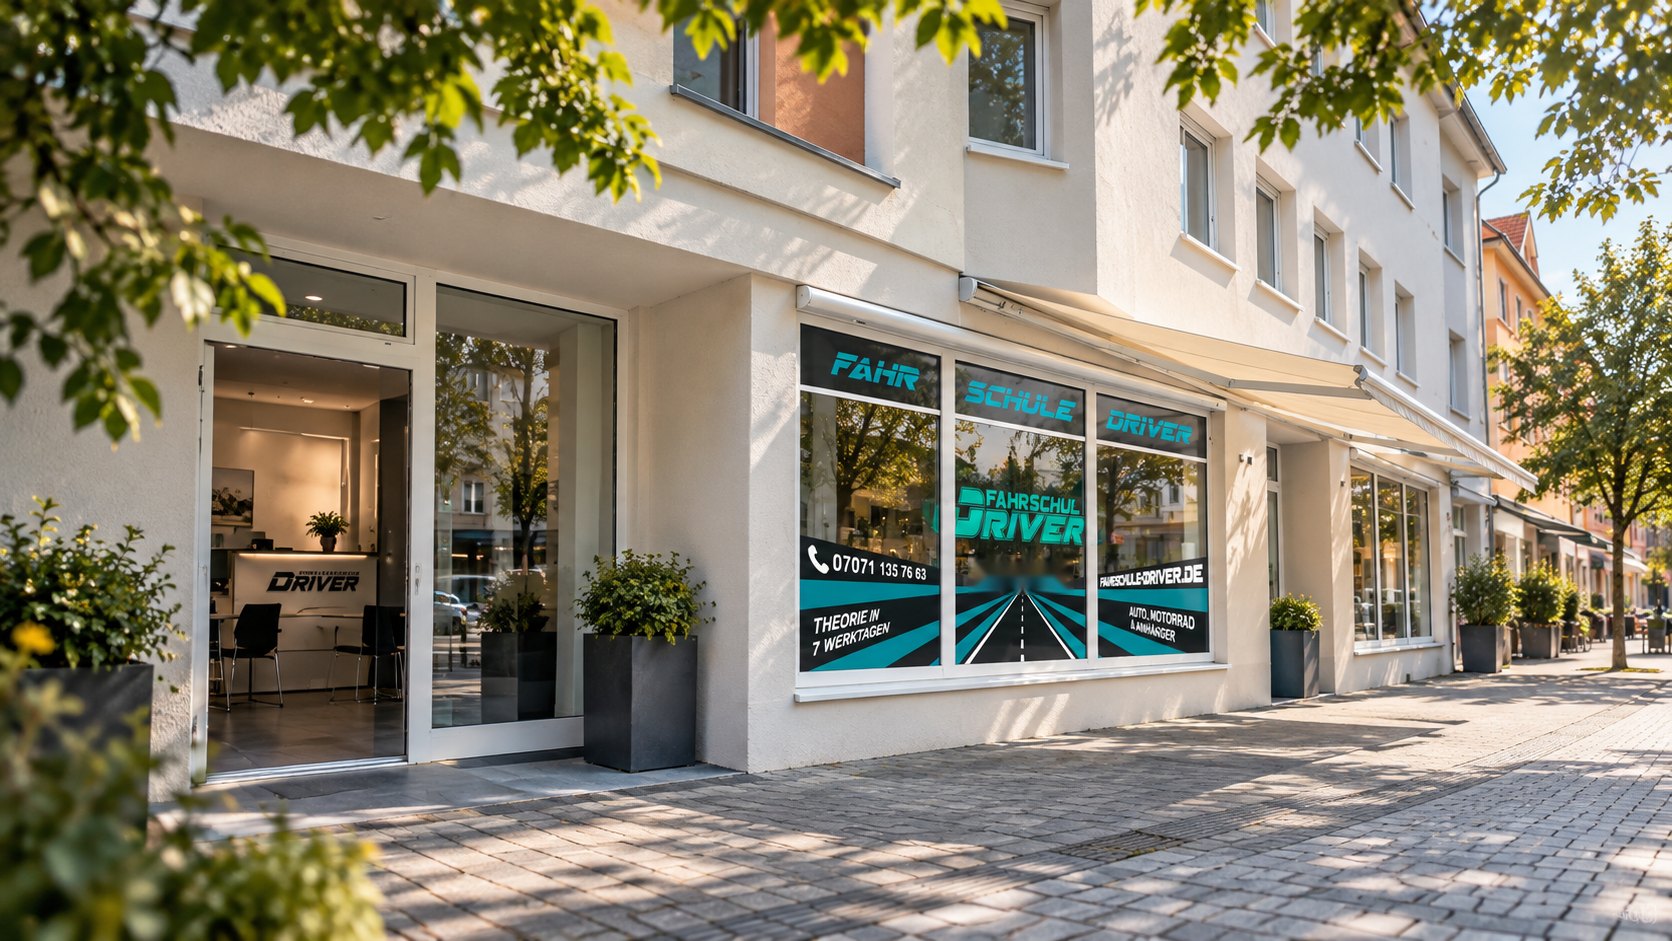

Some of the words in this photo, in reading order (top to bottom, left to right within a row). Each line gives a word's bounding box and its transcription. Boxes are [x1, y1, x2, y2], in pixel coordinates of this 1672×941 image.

[830, 351, 920, 392] FAHR
[964, 380, 1077, 422] SCHULE
[1105, 408, 1193, 445] DRIVER
[955, 486, 1086, 546] DRIVER
[832, 553, 875, 575] 07071
[880, 562, 899, 578] 135
[900, 565, 913, 579] 76
[915, 567, 927, 580] 63
[266, 571, 360, 592] DRIVER
[813, 609, 869, 635] THEORIE
[869, 608, 880, 622] IN
[1150, 609, 1196, 630] MOTORRAD
[812, 640, 821, 657] 7
[823, 622, 891, 653] WERKTAGEN
